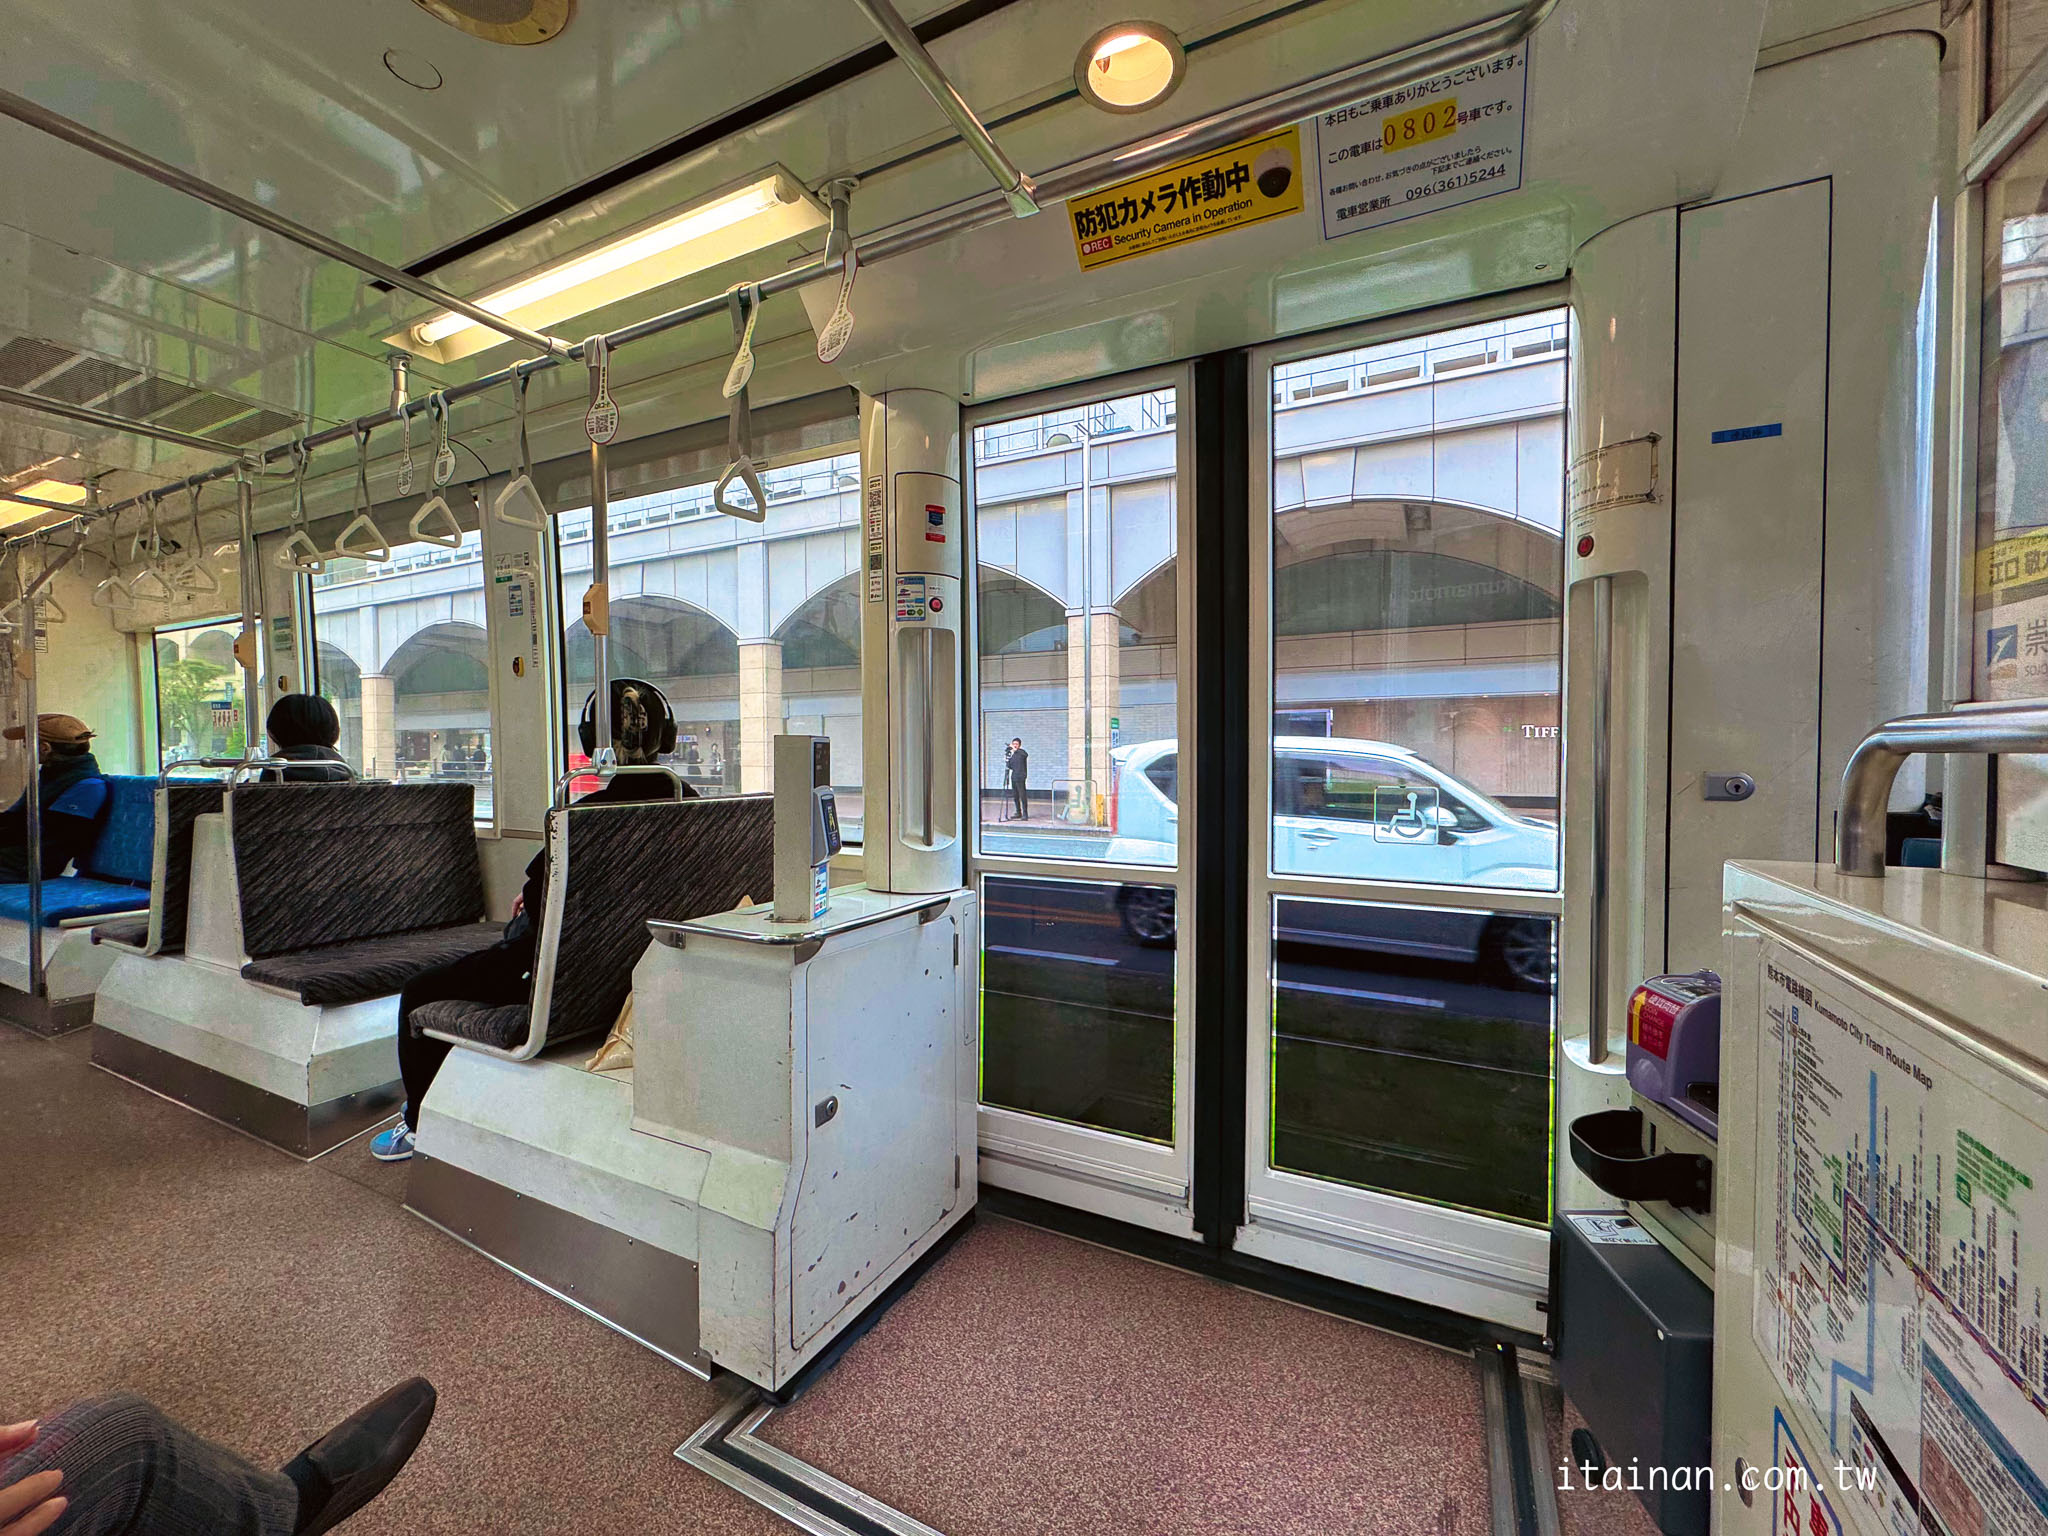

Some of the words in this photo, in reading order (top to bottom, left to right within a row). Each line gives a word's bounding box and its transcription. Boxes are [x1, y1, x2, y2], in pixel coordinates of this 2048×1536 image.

[1325, 54, 1523, 127] 本日もご乗車ありがとうございます。
[1384, 105, 1457, 146] 0802
[1074, 161, 1250, 240] 防犯カメラ作動中
[1336, 195, 1391, 220] 電車営業所
[1406, 163, 1506, 200] 096(361)5244
[1091, 238, 1110, 252] REC
[1114, 228, 1151, 245] Security
[1153, 213, 1190, 234] Camera
[1193, 209, 1201, 223] in
[1204, 198, 1253, 220] Operation
[1768, 963, 1813, 1008] 熊本市電路線図
[1815, 999, 1848, 1032] Kumamoto
[1850, 1023, 1863, 1045] City
[1865, 1032, 1884, 1057] Tram
[1886, 1046, 1911, 1075] Route
[1913, 1063, 1933, 1092] Map
